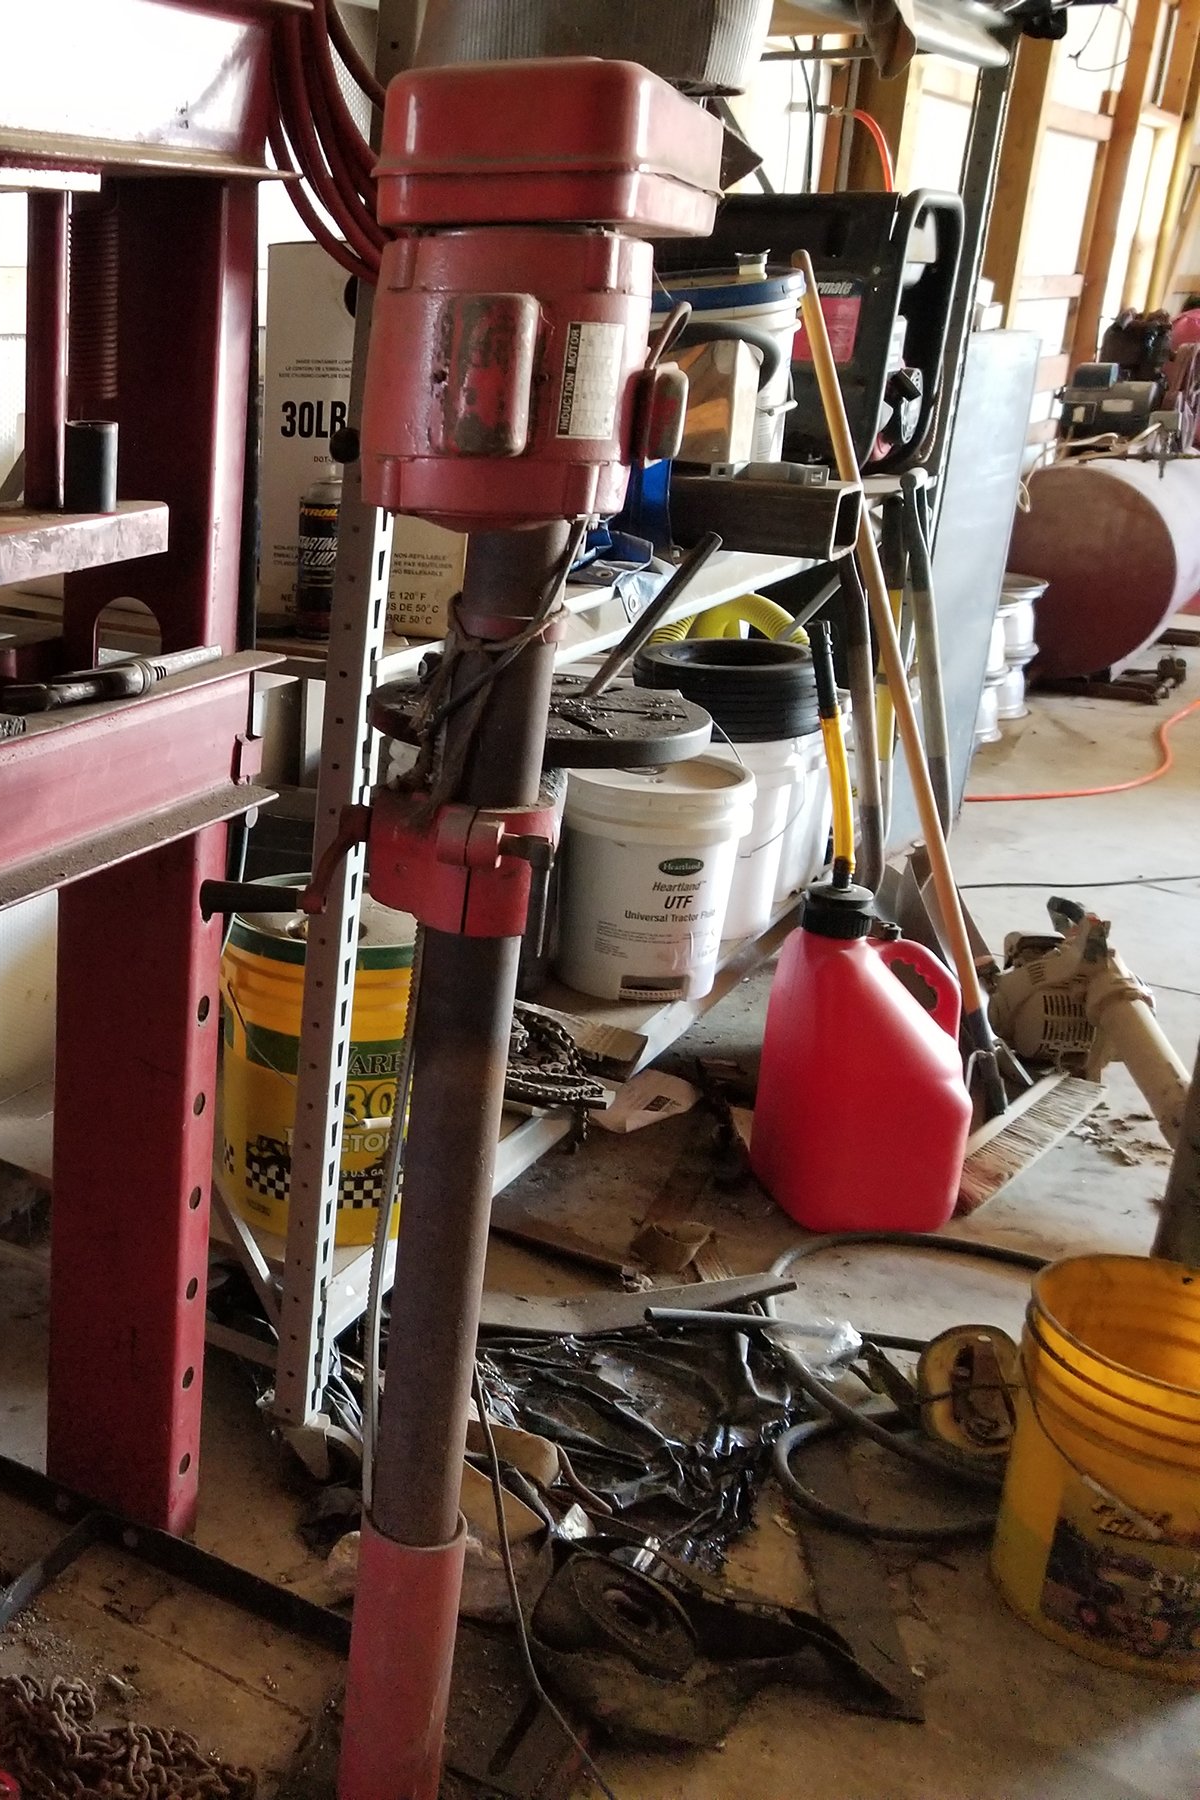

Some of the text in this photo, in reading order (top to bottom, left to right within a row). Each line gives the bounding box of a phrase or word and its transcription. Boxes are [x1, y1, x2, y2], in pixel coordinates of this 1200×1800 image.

[816, 282, 853, 294] rmate
[560, 328, 580, 430] INDUCTION MOTOR
[303, 551, 337, 566] FLUID
[400, 603, 412, 611] DE
[664, 895, 693, 909] UTF
[624, 910, 668, 922] Universal
[671, 912, 699, 922] Tractor
[350, 1169, 369, 1178] U.S.
